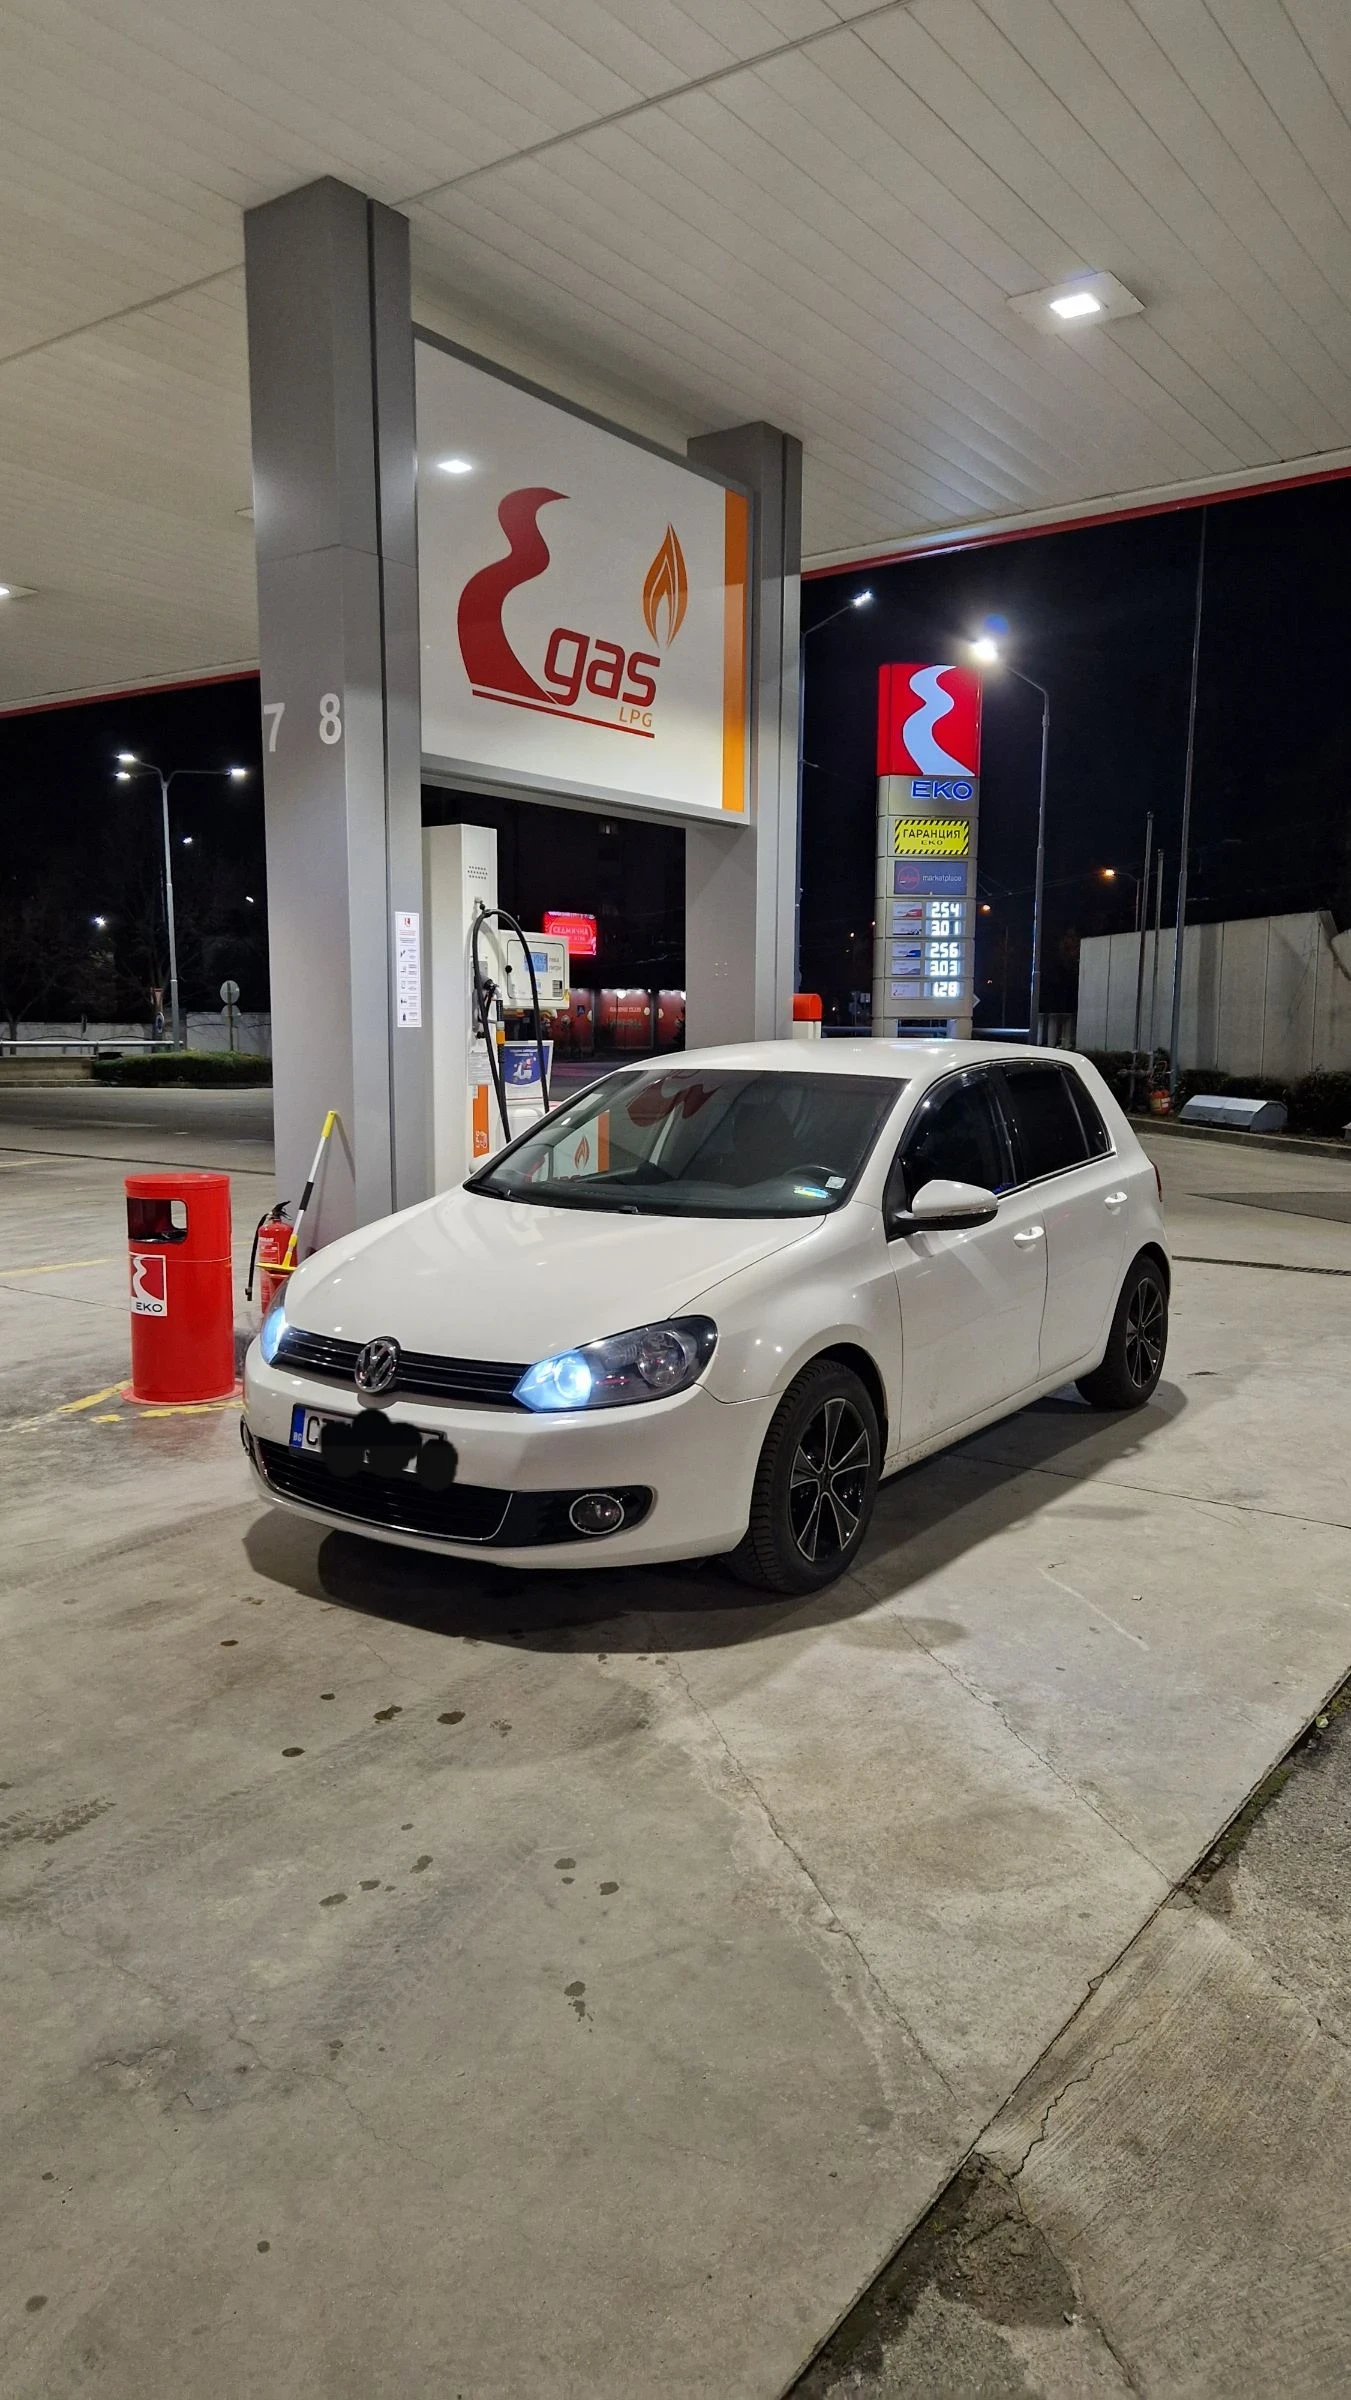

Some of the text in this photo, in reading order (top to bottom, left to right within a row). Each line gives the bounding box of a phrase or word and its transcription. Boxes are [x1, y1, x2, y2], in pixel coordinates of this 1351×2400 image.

[544, 627, 661, 707] gas
[263, 692, 342, 752] 7 8
[619, 706, 653, 728] LPG
[911, 780, 974, 800] EKO
[903, 829, 961, 839] ГАРАНЦИЯ
[922, 873, 962, 882] marketplace
[136, 1302, 163, 1313] EKO
[293, 1431, 303, 1442] BG
